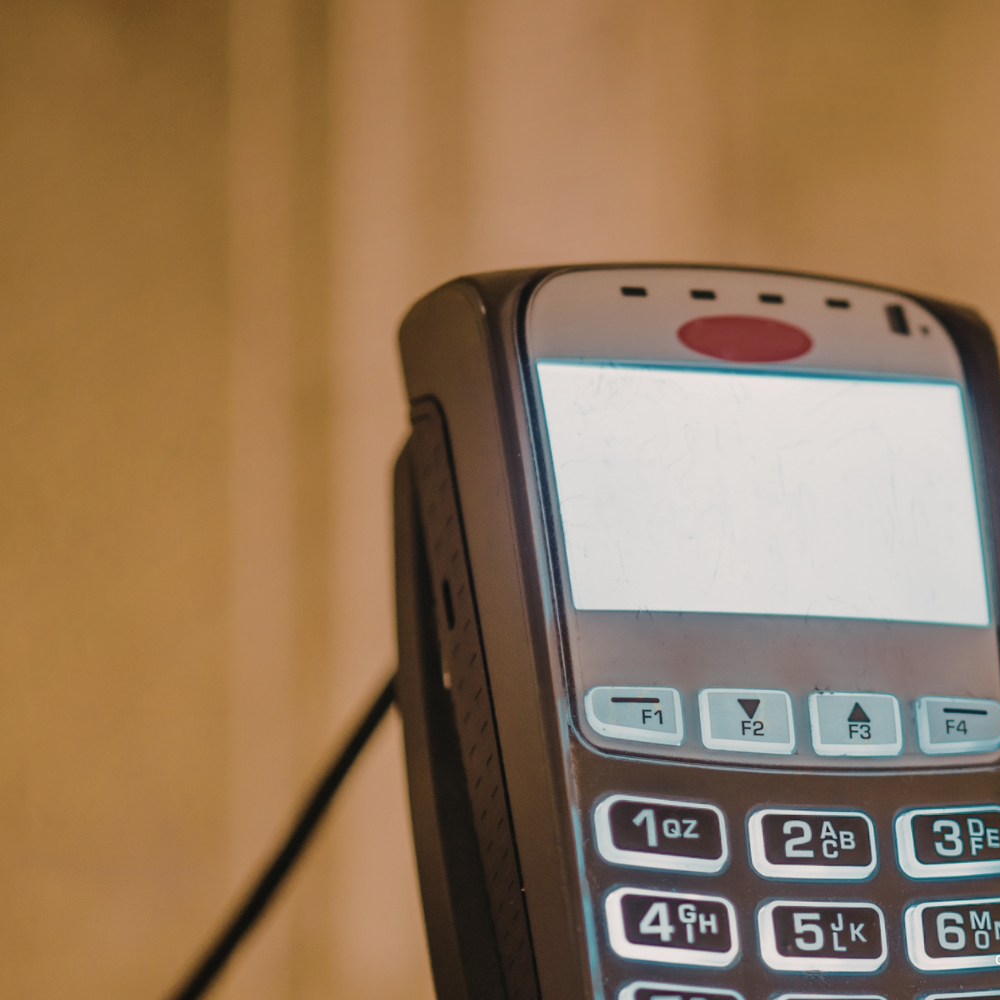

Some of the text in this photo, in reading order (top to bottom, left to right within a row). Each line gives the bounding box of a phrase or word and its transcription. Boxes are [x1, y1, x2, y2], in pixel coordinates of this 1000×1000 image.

[641, 709, 665, 725] F1
[741, 720, 765, 737] F2
[848, 723, 872, 740] F3
[945, 718, 968, 735] F4
[662, 818, 700, 839] QZ
